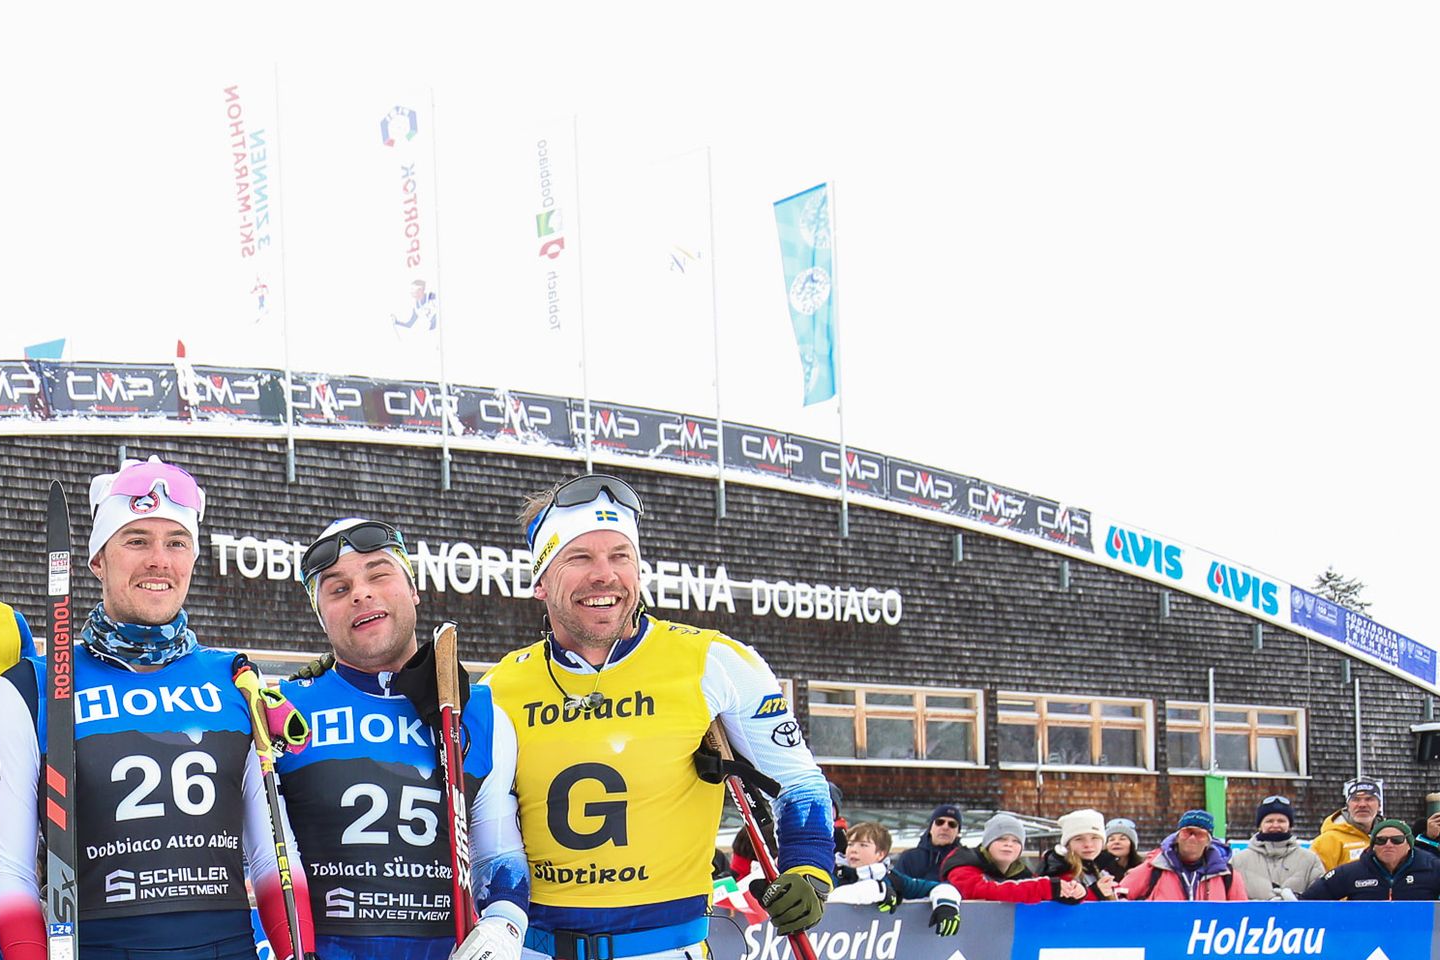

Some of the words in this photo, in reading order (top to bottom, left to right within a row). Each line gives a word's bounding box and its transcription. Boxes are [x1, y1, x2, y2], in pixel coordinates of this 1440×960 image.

[66, 371, 154, 402] CMP
[479, 396, 551, 427] CMP
[571, 410, 639, 440] CMP
[741, 434, 803, 465] CMP
[820, 450, 880, 482] CMP
[896, 467, 953, 501] CMP
[1036, 505, 1089, 536] CMP
[1105, 526, 1184, 580] AVIS
[639, 560, 736, 614] RENA
[752, 579, 902, 626] DOBBIACO
[1207, 561, 1279, 616] AVIS
[54, 596, 71, 700] ROSSIGNOL
[75, 682, 223, 724] HOKU
[311, 706, 440, 748] HOK
[111, 751, 218, 822] 26
[340, 783, 442, 847] 25
[547, 762, 628, 851] G
[86, 838, 161, 860] Dobbiaco
[166, 833, 206, 849] ALTO
[140, 866, 228, 884] SCHILLER
[277, 842, 291, 889] LEKI
[310, 863, 377, 878] Toblach
[140, 883, 229, 899] INVESTMENT
[359, 892, 451, 907] SCHILLER
[358, 908, 450, 921] INVESTMENT
[1186, 917, 1326, 956] Holzbau
